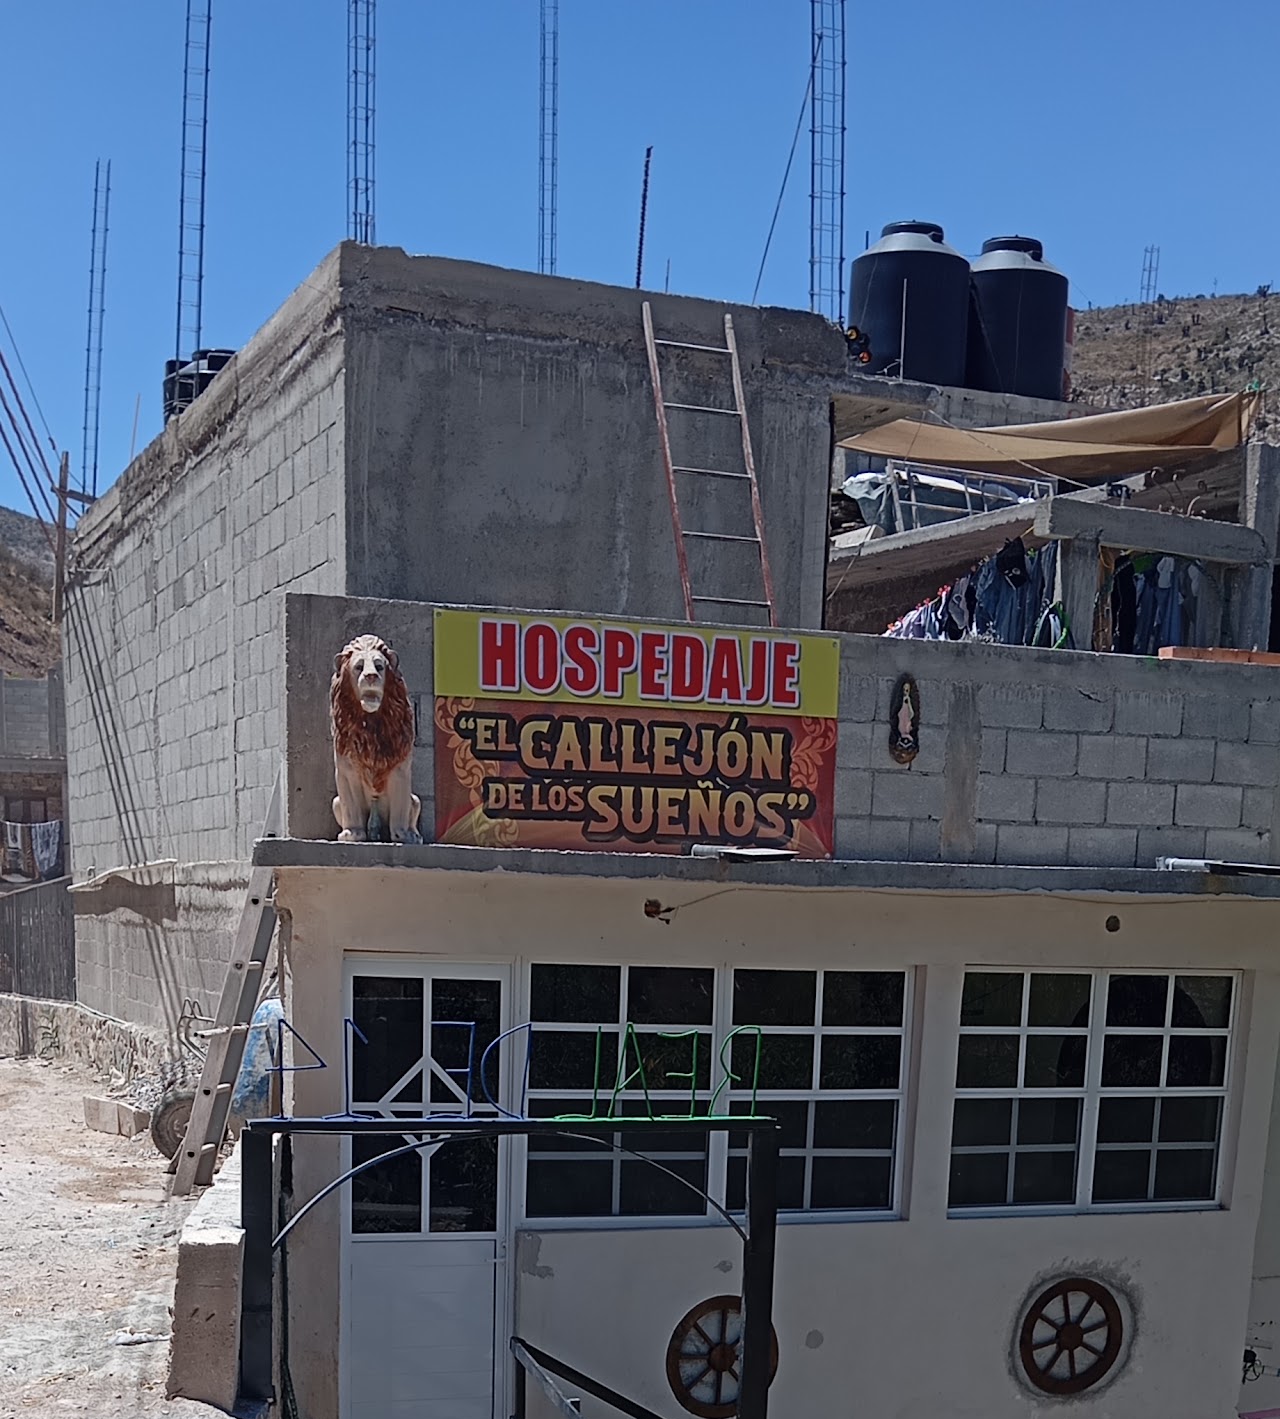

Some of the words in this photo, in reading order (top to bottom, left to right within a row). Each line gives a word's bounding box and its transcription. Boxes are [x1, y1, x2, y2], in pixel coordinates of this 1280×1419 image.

[480, 618, 800, 708] HOSPEDAJE
[520, 718, 784, 780] CALLEJÓN
[487, 782, 526, 811] DE
[531, 784, 586, 813] LOS
